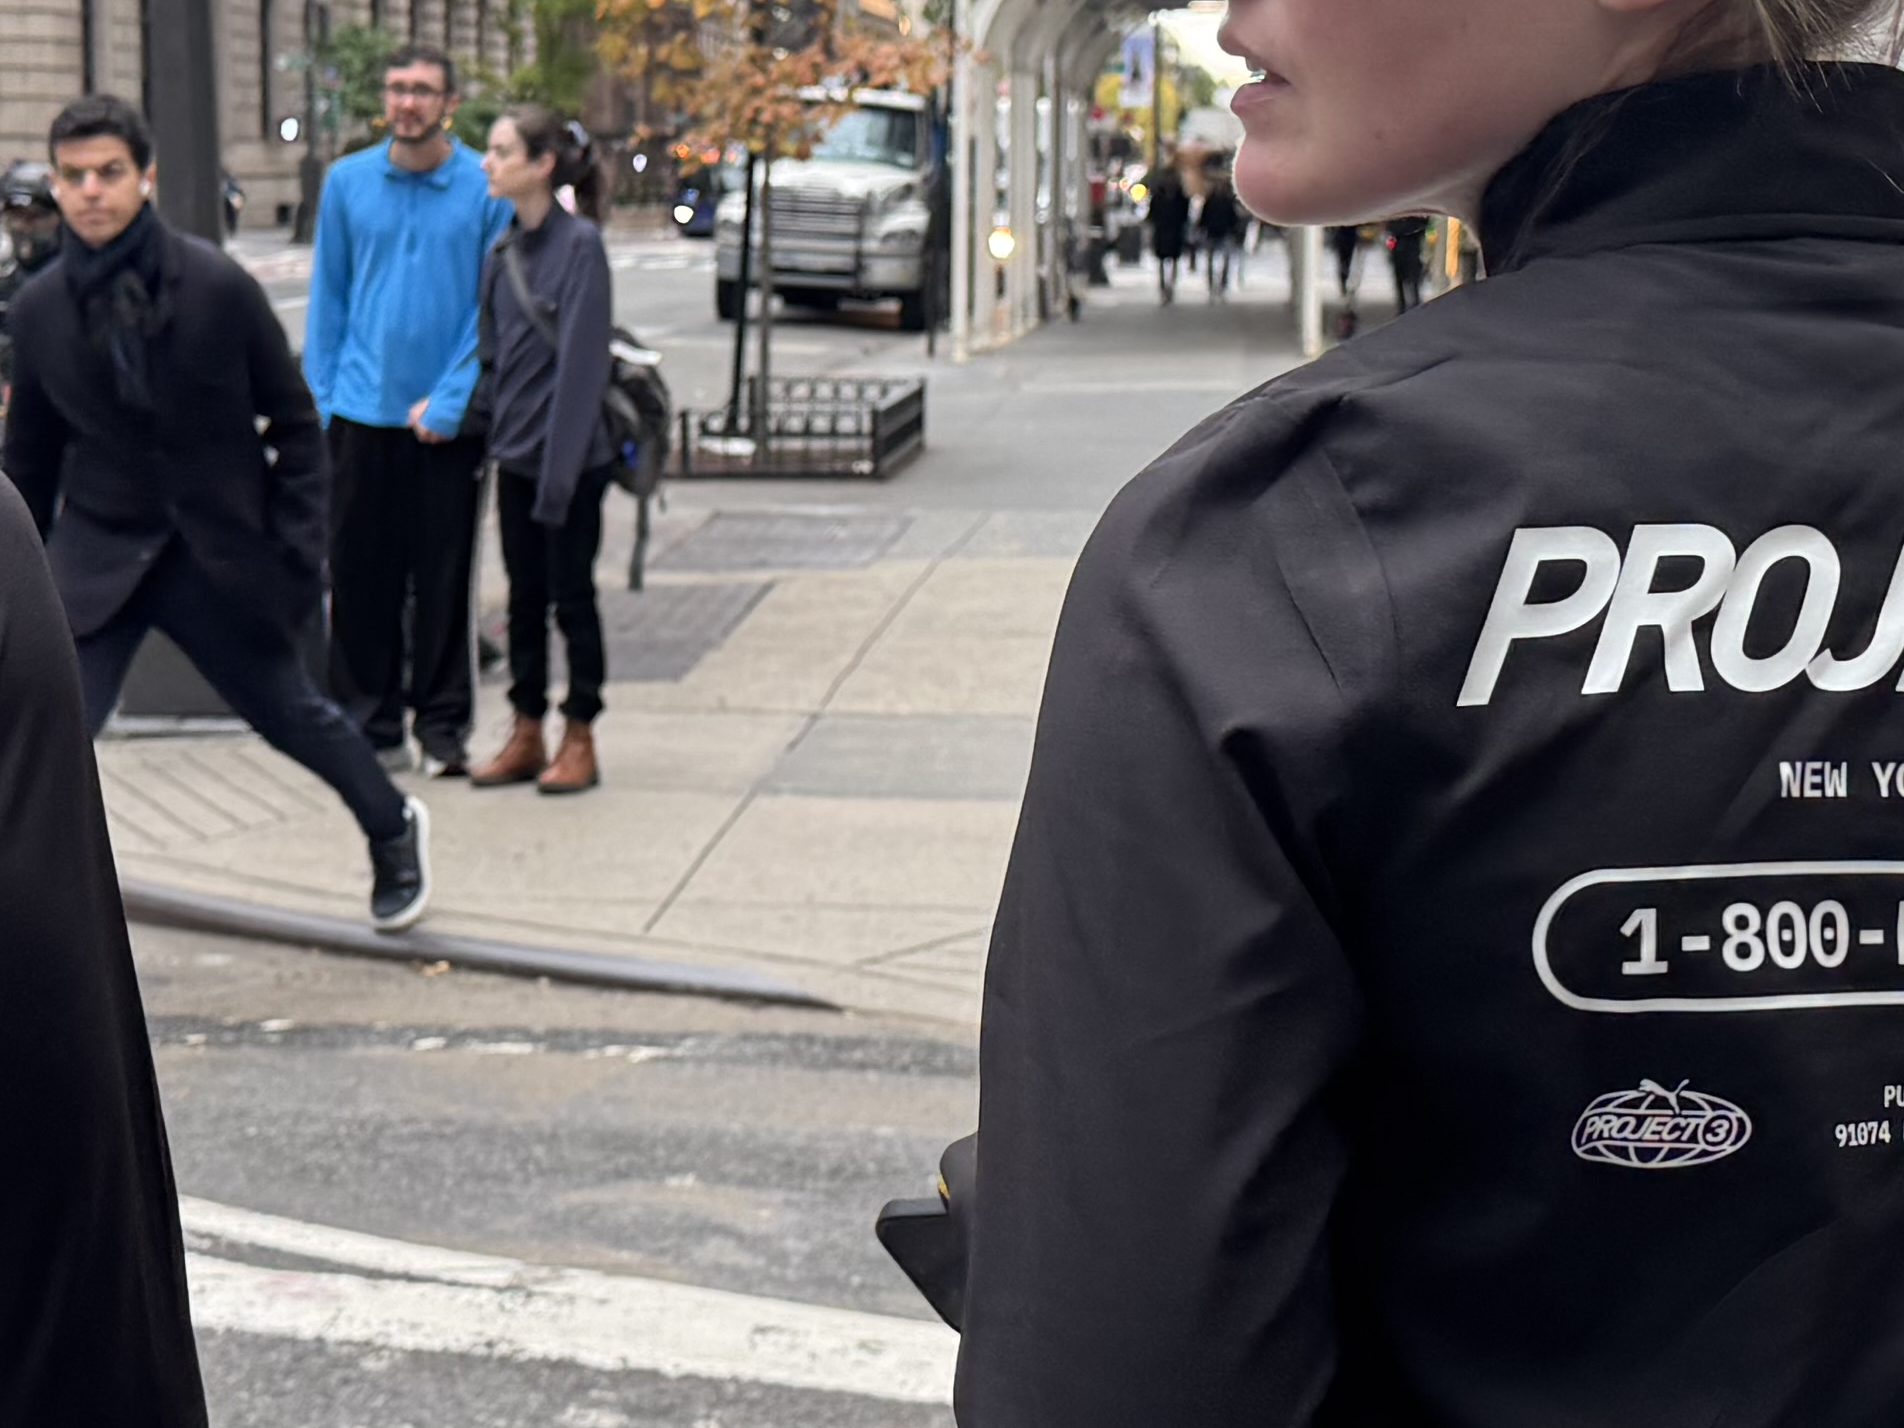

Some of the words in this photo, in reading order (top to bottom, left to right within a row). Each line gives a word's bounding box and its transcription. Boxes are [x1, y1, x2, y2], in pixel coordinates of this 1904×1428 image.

[1779, 761, 1848, 798] NEW
[1581, 1114, 1702, 1144] PROJECT
[1705, 1119, 1730, 1143] 3
[1835, 1120, 1892, 1148] 91074
